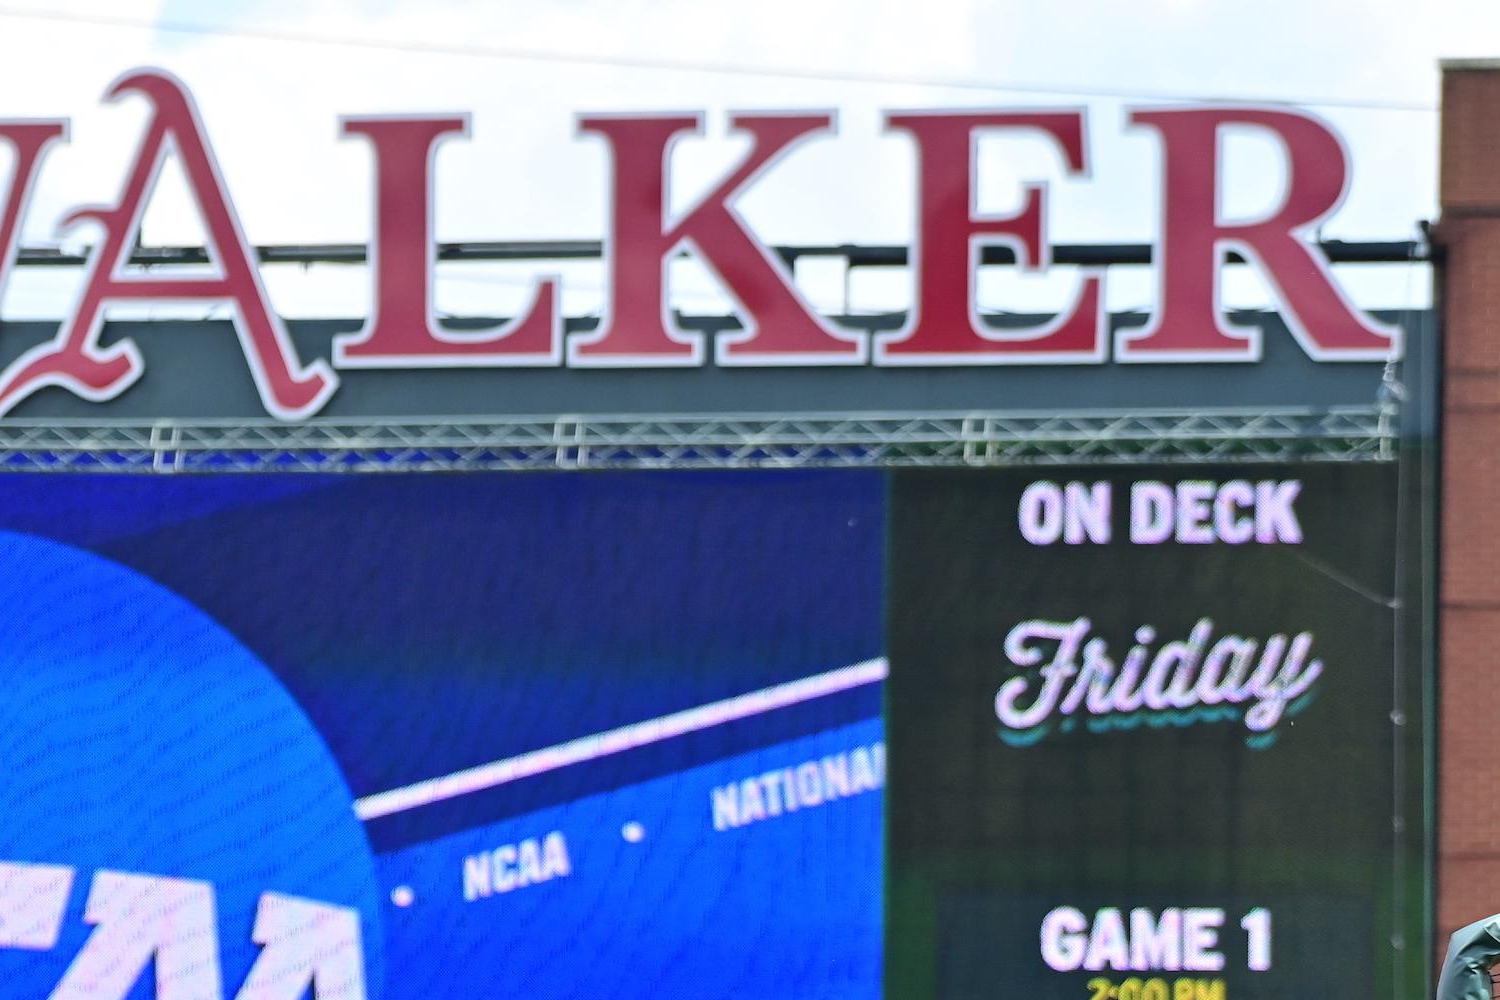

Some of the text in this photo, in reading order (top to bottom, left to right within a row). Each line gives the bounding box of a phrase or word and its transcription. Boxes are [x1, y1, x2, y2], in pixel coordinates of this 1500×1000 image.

[1017, 479, 1303, 546] ON DECK
[994, 616, 1324, 734] Friday
[463, 831, 571, 901] NCAA
[1039, 905, 1272, 973] GAME 1
